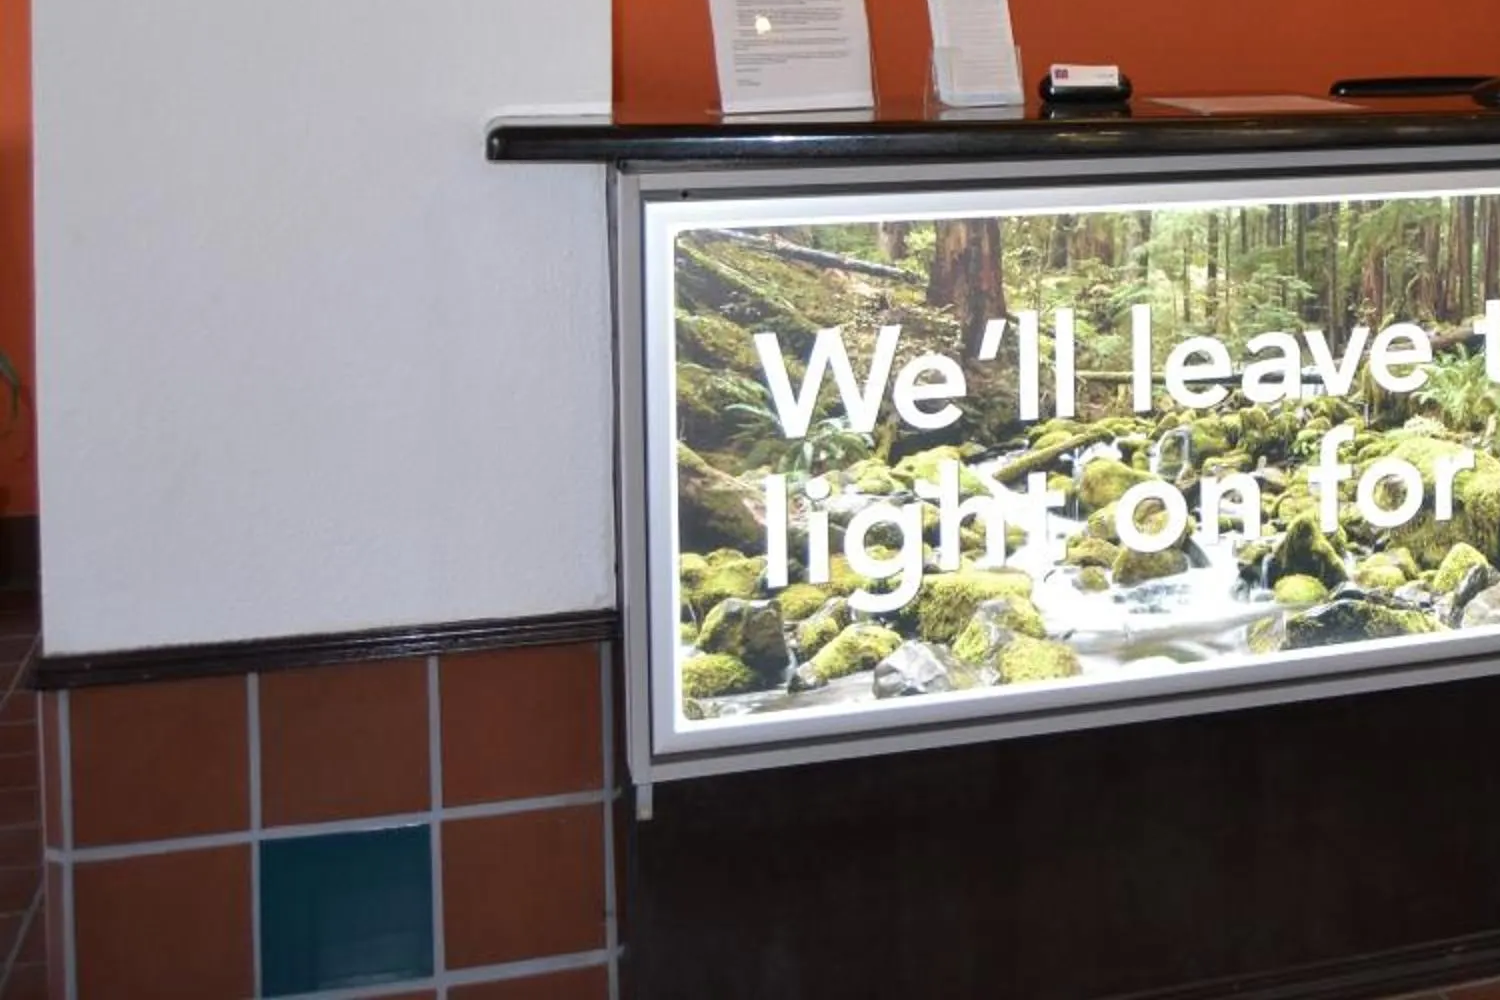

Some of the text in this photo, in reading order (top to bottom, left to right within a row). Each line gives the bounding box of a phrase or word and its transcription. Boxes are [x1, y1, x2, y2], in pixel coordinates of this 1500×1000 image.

[754, 308, 1075, 440] We'll
[1132, 303, 1434, 413] leave
[765, 460, 1067, 613] light
[1115, 470, 1261, 553] on
[1307, 426, 1475, 533] for
